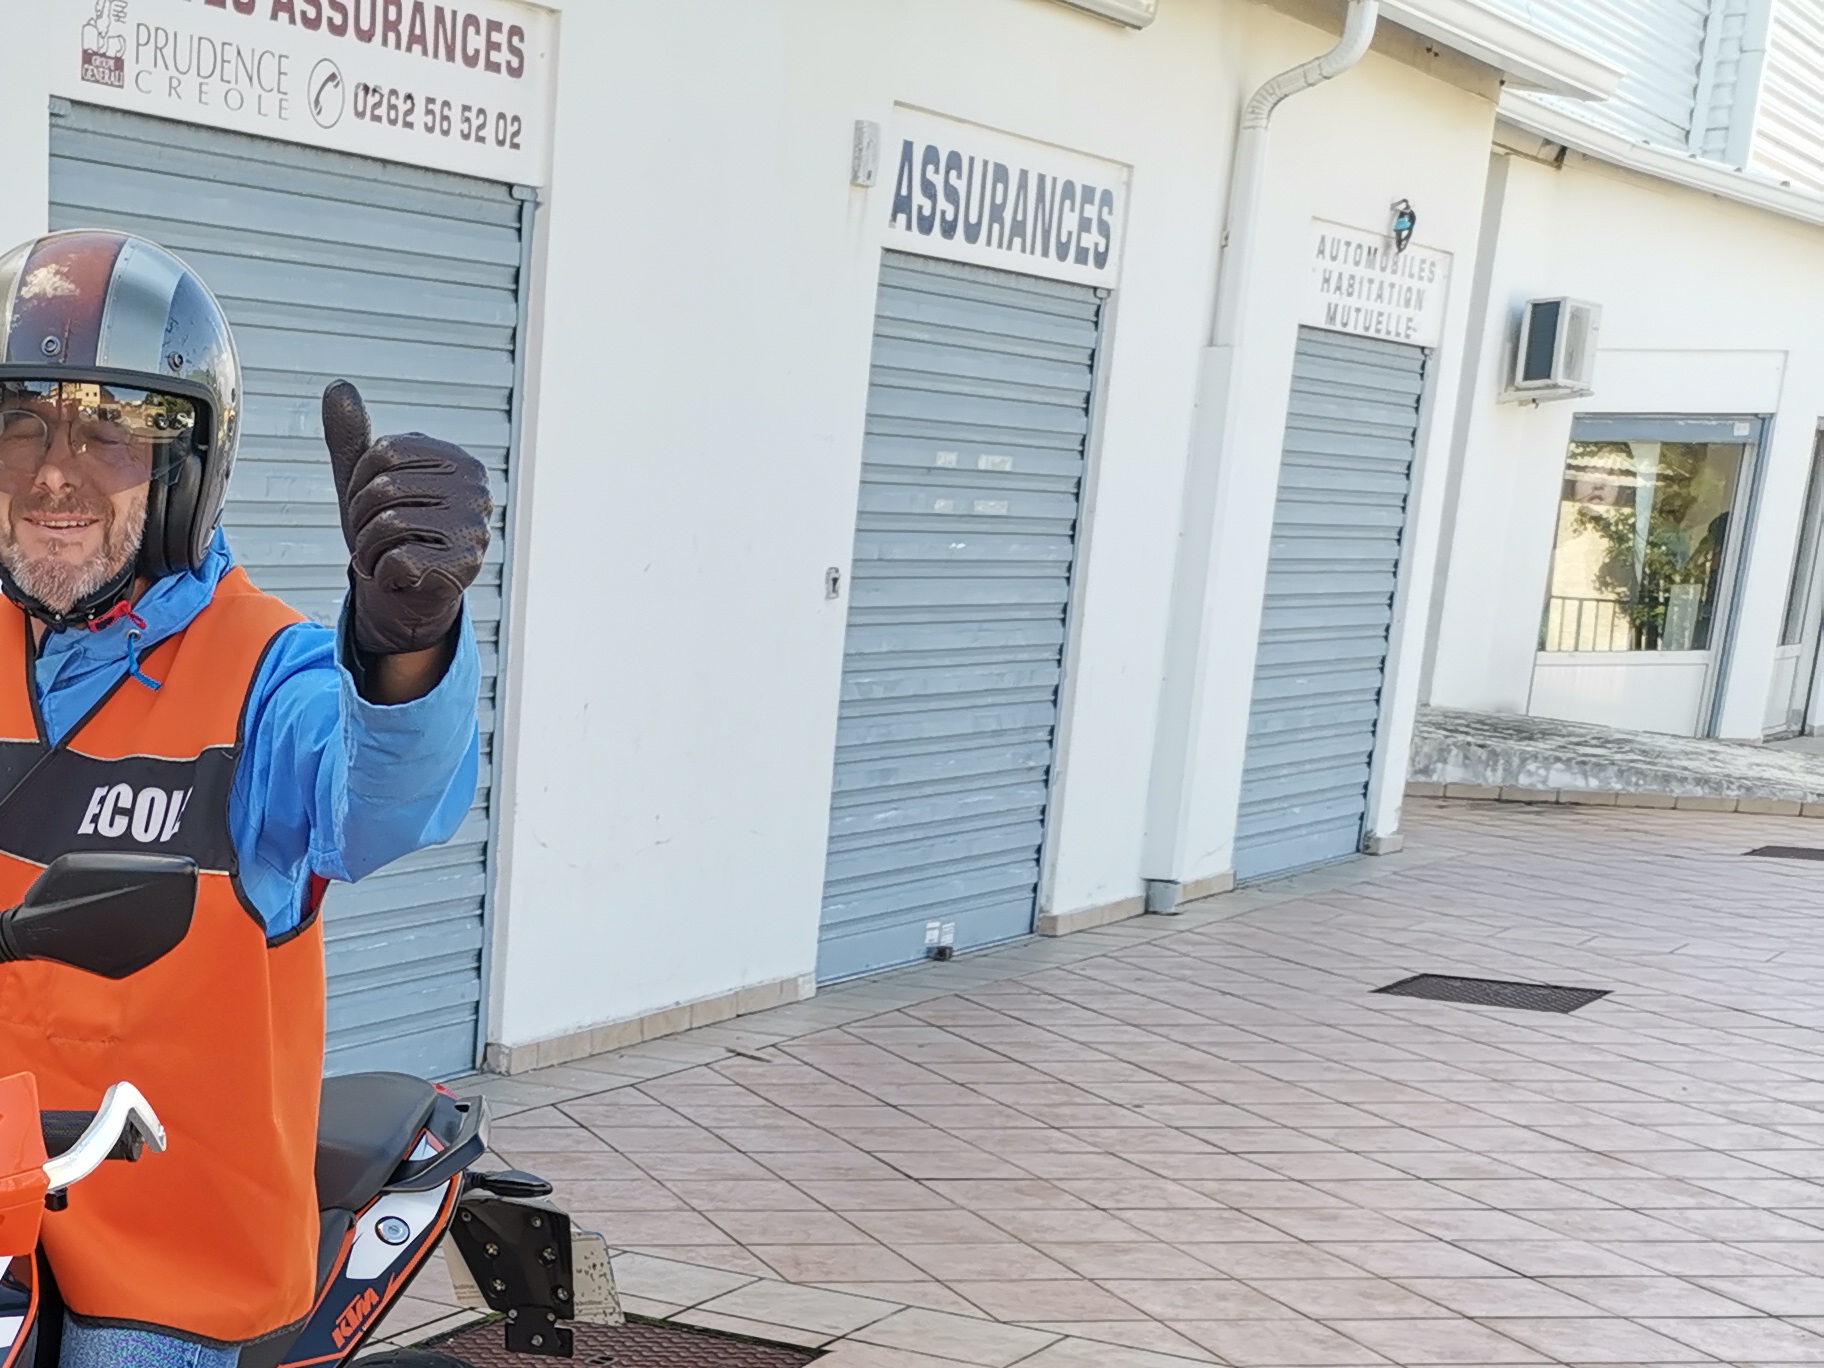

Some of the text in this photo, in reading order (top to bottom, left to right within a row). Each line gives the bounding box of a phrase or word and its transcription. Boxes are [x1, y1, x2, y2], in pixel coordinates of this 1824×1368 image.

[82, 65, 124, 85] GENERALI
[135, 22, 290, 96] PRUDENCE
[134, 69, 289, 121] CREOLE
[353, 82, 522, 150] 0262 56 52 02
[888, 139, 1114, 271] ASSURANCES
[1316, 235, 1436, 284] AUTOMOBILES
[1320, 268, 1426, 312] HABITATION
[1325, 302, 1415, 340] MUTUELLE
[77, 782, 194, 843] ECOL
[332, 1287, 380, 1348] KTM
